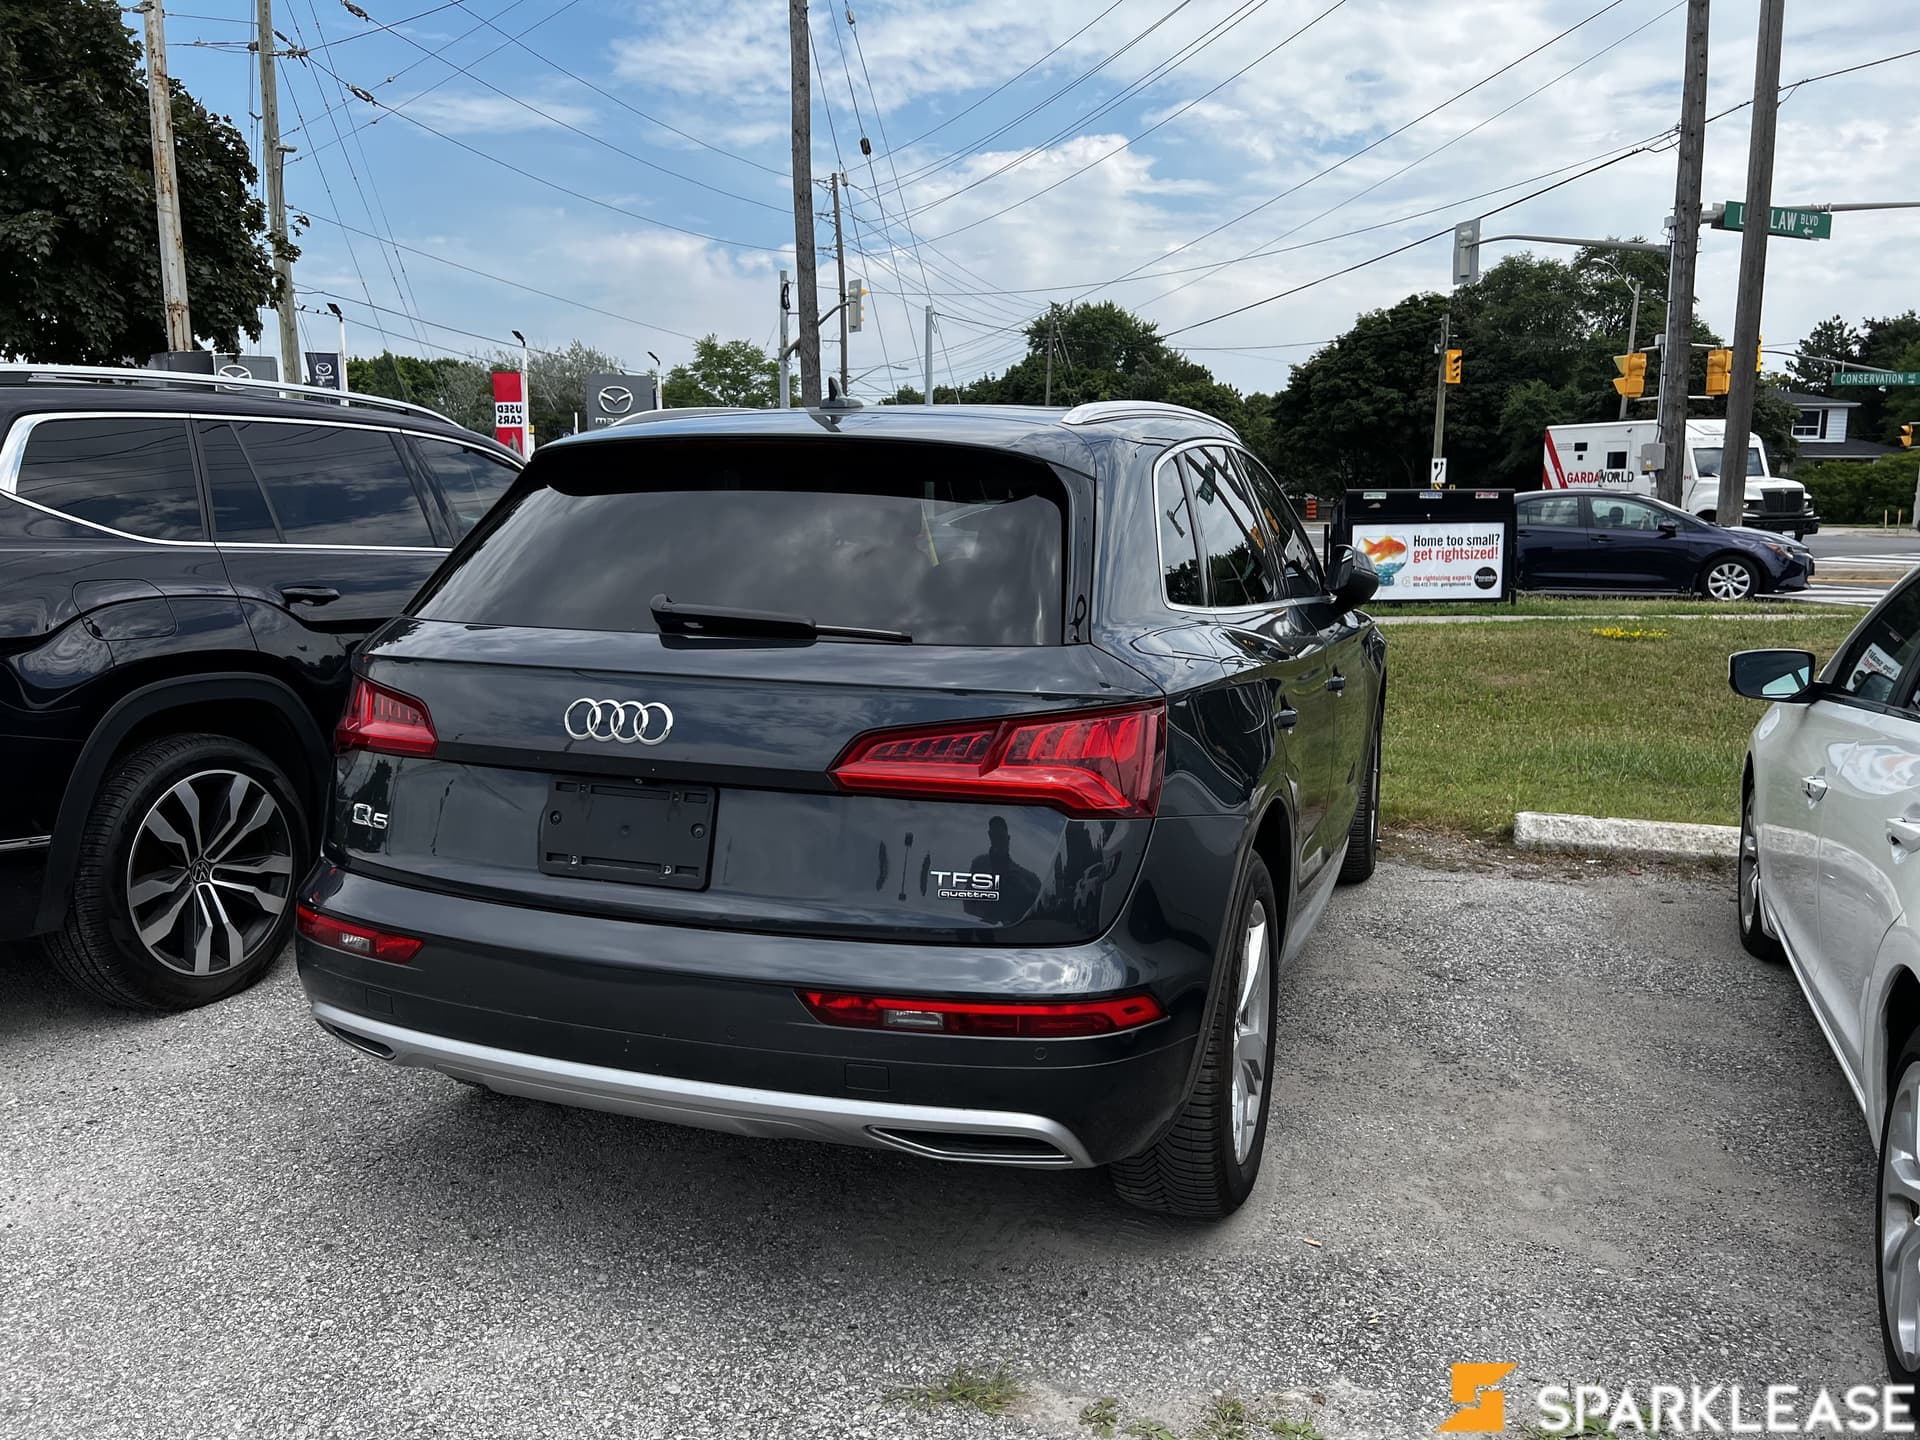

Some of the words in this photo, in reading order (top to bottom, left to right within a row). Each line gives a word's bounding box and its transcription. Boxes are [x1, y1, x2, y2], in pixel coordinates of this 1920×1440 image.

[1739, 205, 1797, 232] LLAW
[1800, 213, 1819, 227] BLVD
[1840, 373, 1904, 385] CONSERVATION
[1413, 535, 1443, 547] Home
[1446, 534, 1464, 546] too
[1466, 533, 1501, 546] small?
[1413, 547, 1433, 564] get
[1436, 546, 1499, 563] rightsized!
[352, 802, 389, 829] Q5
[930, 870, 1000, 890] TFSI
[940, 890, 997, 899] quattro
